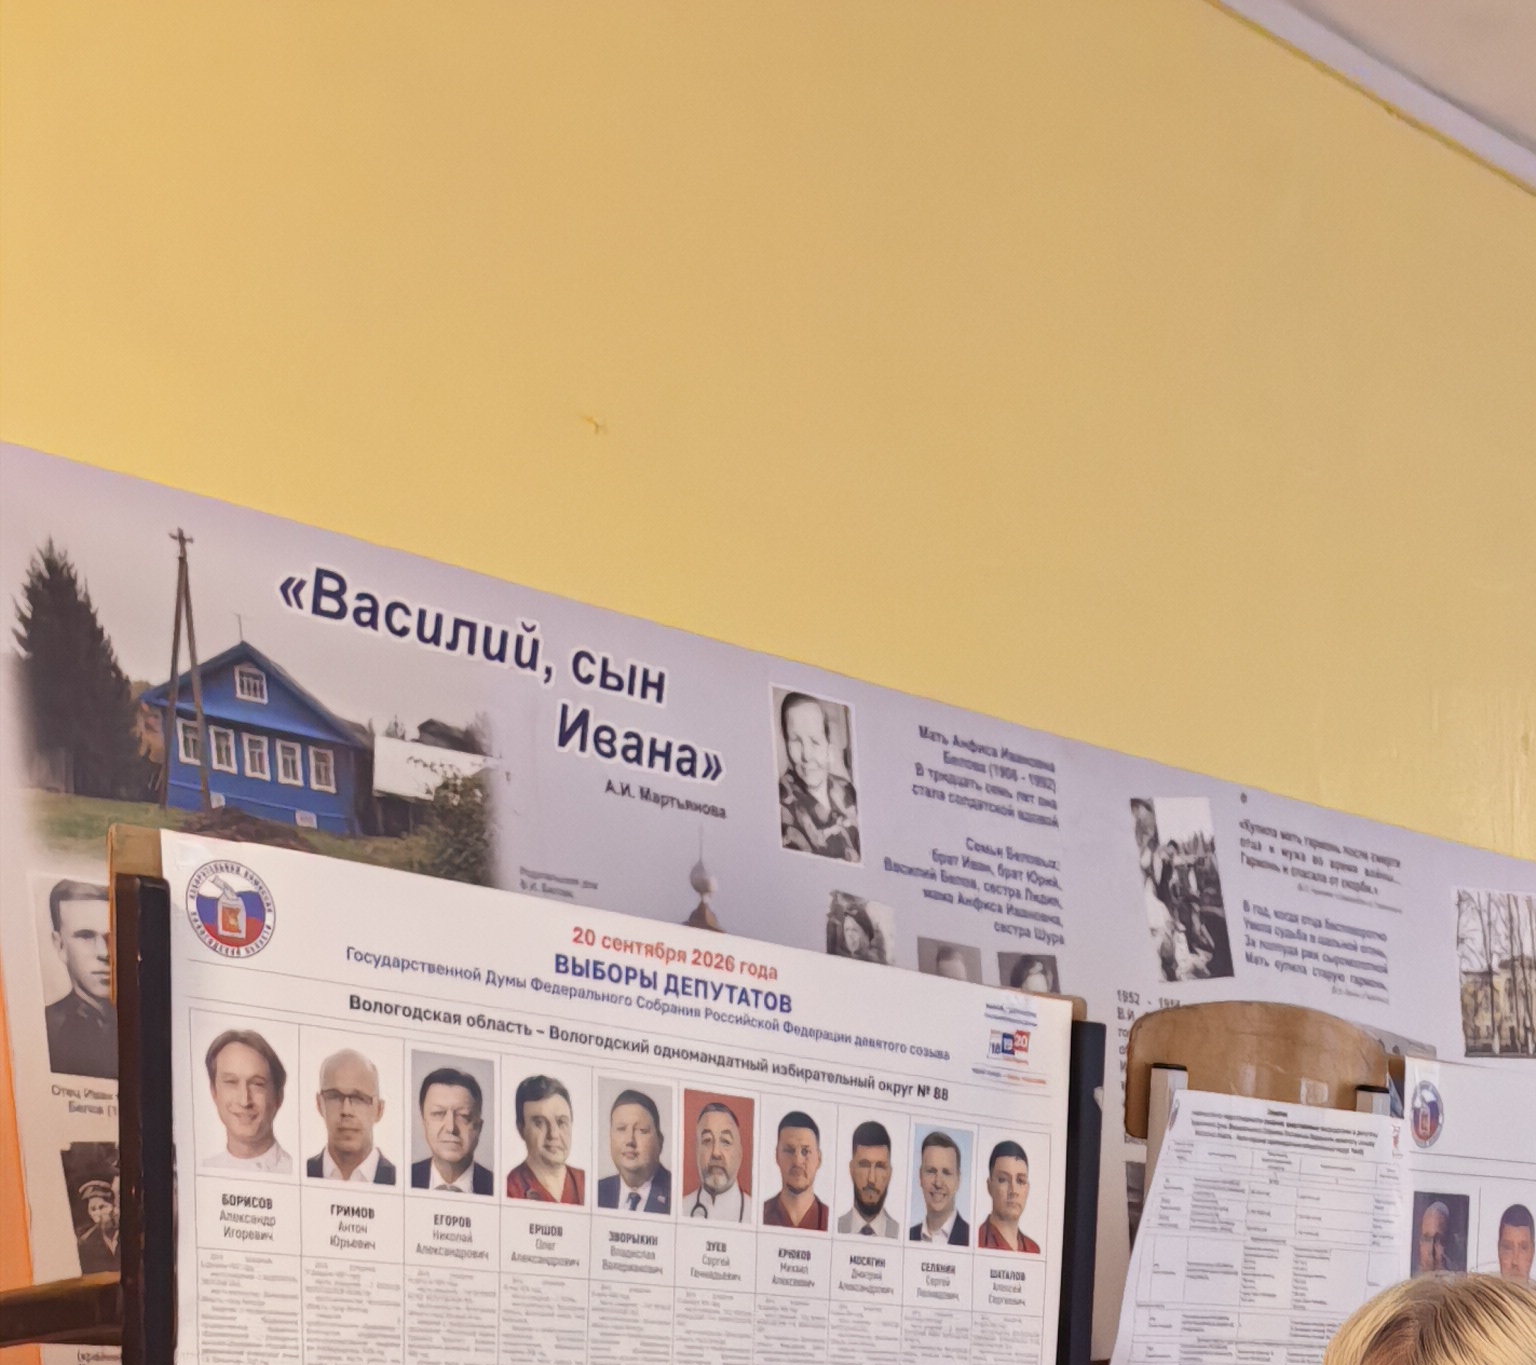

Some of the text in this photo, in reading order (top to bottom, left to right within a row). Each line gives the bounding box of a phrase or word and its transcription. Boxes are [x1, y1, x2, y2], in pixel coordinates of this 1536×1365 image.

[279, 566, 666, 704] «Василий, сын
[557, 701, 723, 783] Ивана»
[639, 785, 727, 819] Мартьянова
[572, 926, 779, 981] 20 сентября 2026 года
[554, 953, 793, 1014] ВЫБОРЫ ДЕПУТАТОВ
[346, 946, 951, 1061] Государственной Думы Федерального Собрания Российской Федерации девятого созыва
[349, 994, 462, 1026] Вологодская
[466, 1014, 533, 1036] область
[549, 1025, 650, 1055] Вологодский
[653, 1043, 769, 1073] одномандатный
[772, 1062, 875, 1090] избирательный
[878, 1079, 913, 1098] округ
[917, 1083, 931, 1098] №
[222, 1193, 273, 1210] БОРИСОВ
[220, 1209, 276, 1227] Александр
[330, 1203, 375, 1220] ГРИМОВ
[338, 1220, 368, 1234] Антон
[433, 1214, 472, 1229] ЕГОРОВ
[529, 1223, 563, 1237] ЕРШОВ
[223, 1225, 275, 1242] Игоревич
[432, 1228, 473, 1243] Николай
[608, 1230, 659, 1246] ЗВОРЫКИН
[329, 1235, 376, 1251] Юрьевич
